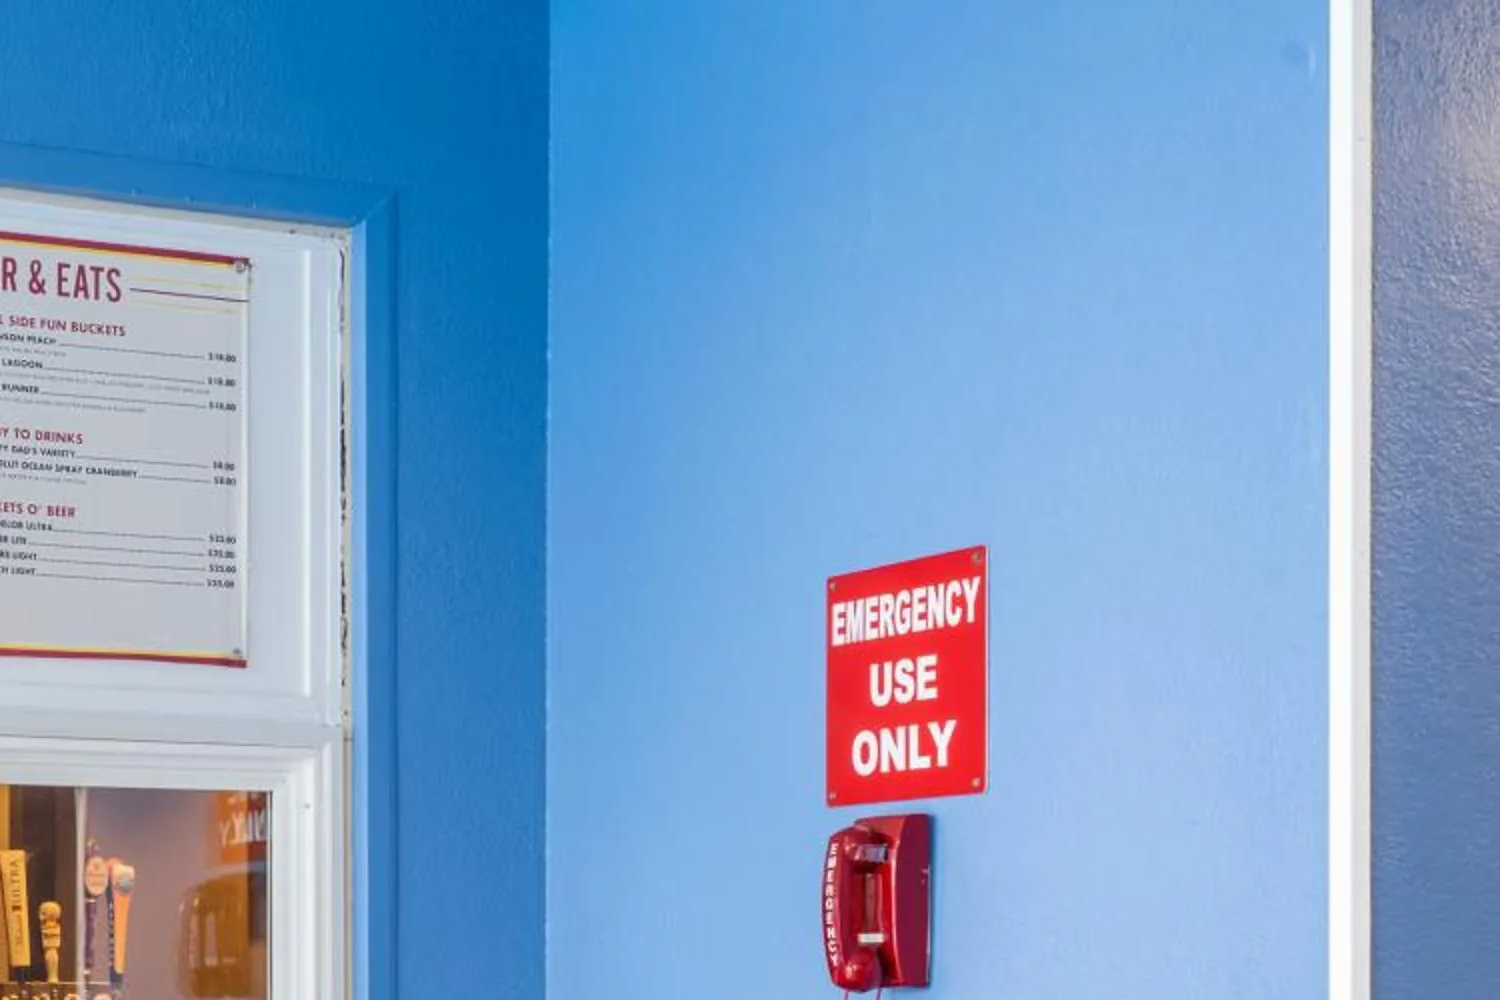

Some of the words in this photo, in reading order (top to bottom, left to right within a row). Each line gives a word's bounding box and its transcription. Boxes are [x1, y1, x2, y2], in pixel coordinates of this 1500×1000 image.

[28, 260, 47, 295] &
[57, 262, 123, 303] EATS
[9, 315, 37, 329] SIDE
[40, 318, 67, 331] FUN
[71, 321, 126, 337] BUCKETS
[2, 357, 43, 369] LAGOON
[13, 427, 32, 441] TO
[36, 430, 84, 445] DRINKS
[46, 505, 76, 518] BEER
[831, 576, 981, 647] EMERGENCY
[869, 654, 938, 707] USE
[852, 720, 957, 777] ONLY
